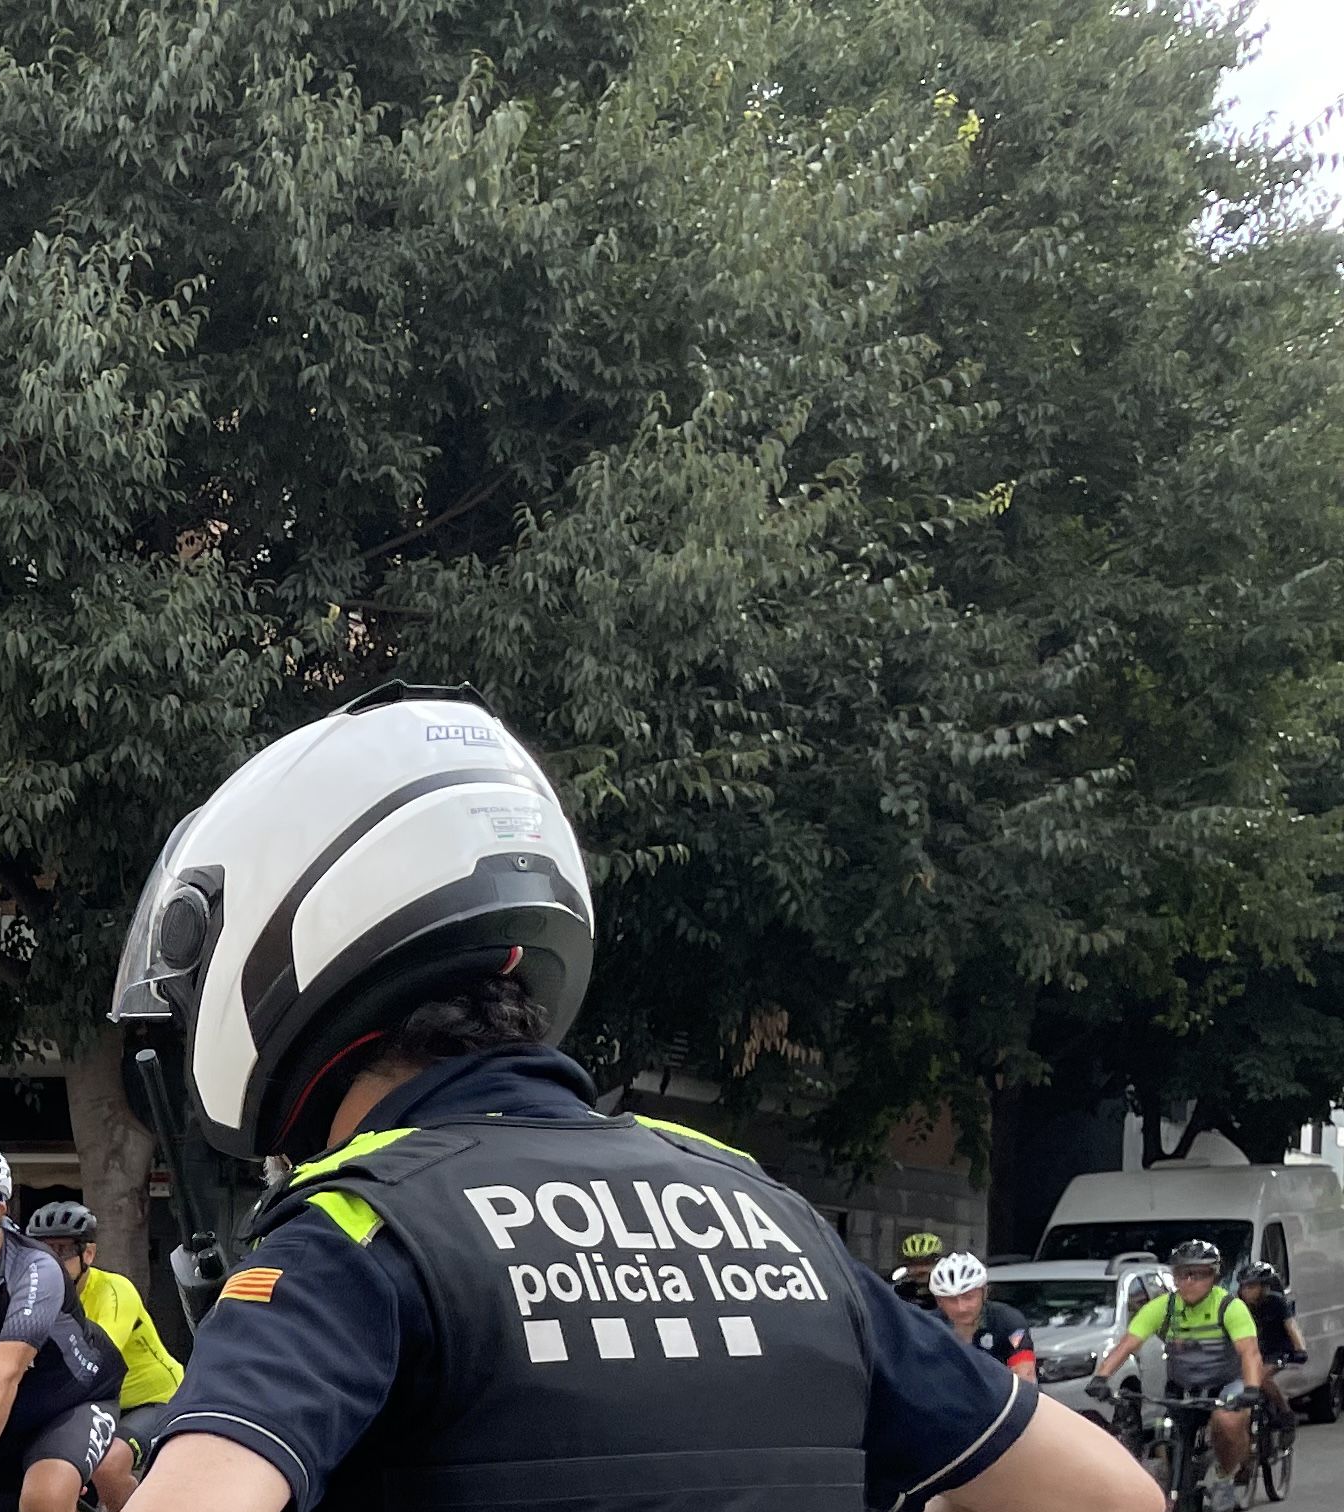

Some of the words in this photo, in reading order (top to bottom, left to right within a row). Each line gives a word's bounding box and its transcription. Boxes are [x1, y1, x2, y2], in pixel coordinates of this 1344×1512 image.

[464, 1180, 803, 1253] POLICIA
[509, 1251, 692, 1316] policia
[704, 1254, 829, 1302] local
